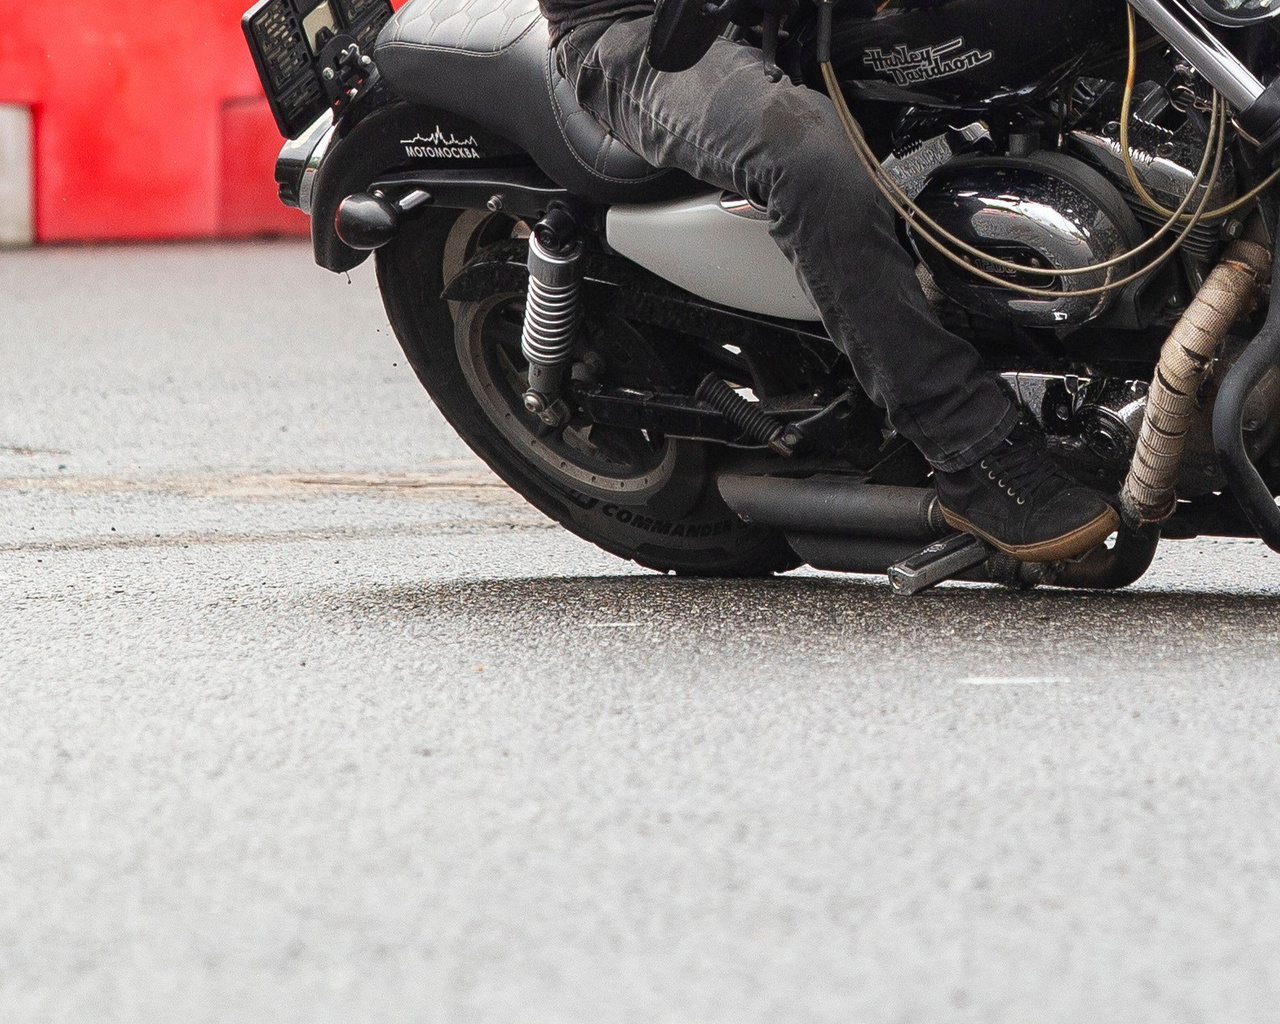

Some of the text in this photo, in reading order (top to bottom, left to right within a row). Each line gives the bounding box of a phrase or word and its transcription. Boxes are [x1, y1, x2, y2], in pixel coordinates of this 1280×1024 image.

[864, 36, 963, 71] Harley
[887, 50, 993, 86] Davidson
[405, 145, 480, 159] МОТОМОСКВА
[602, 503, 732, 539] COMMANDER
